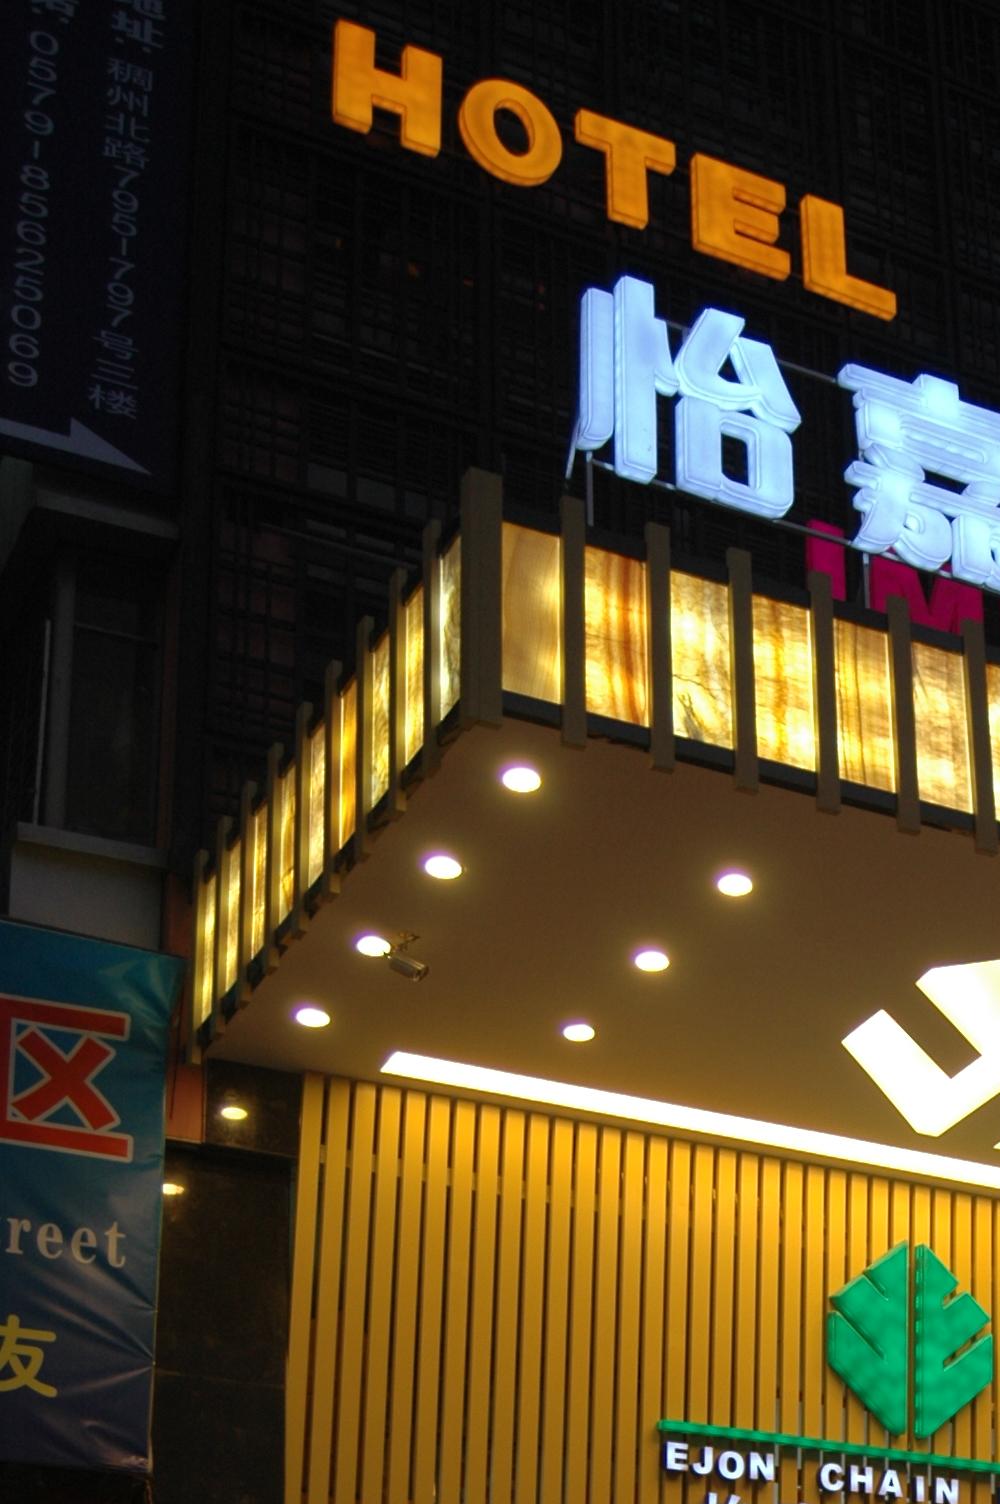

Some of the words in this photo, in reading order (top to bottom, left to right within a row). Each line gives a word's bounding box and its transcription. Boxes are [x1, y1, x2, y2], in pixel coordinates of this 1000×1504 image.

[331, 17, 897, 322] HOTEL
[4, 1216, 128, 1269] reet
[665, 1441, 776, 1482] EJON
